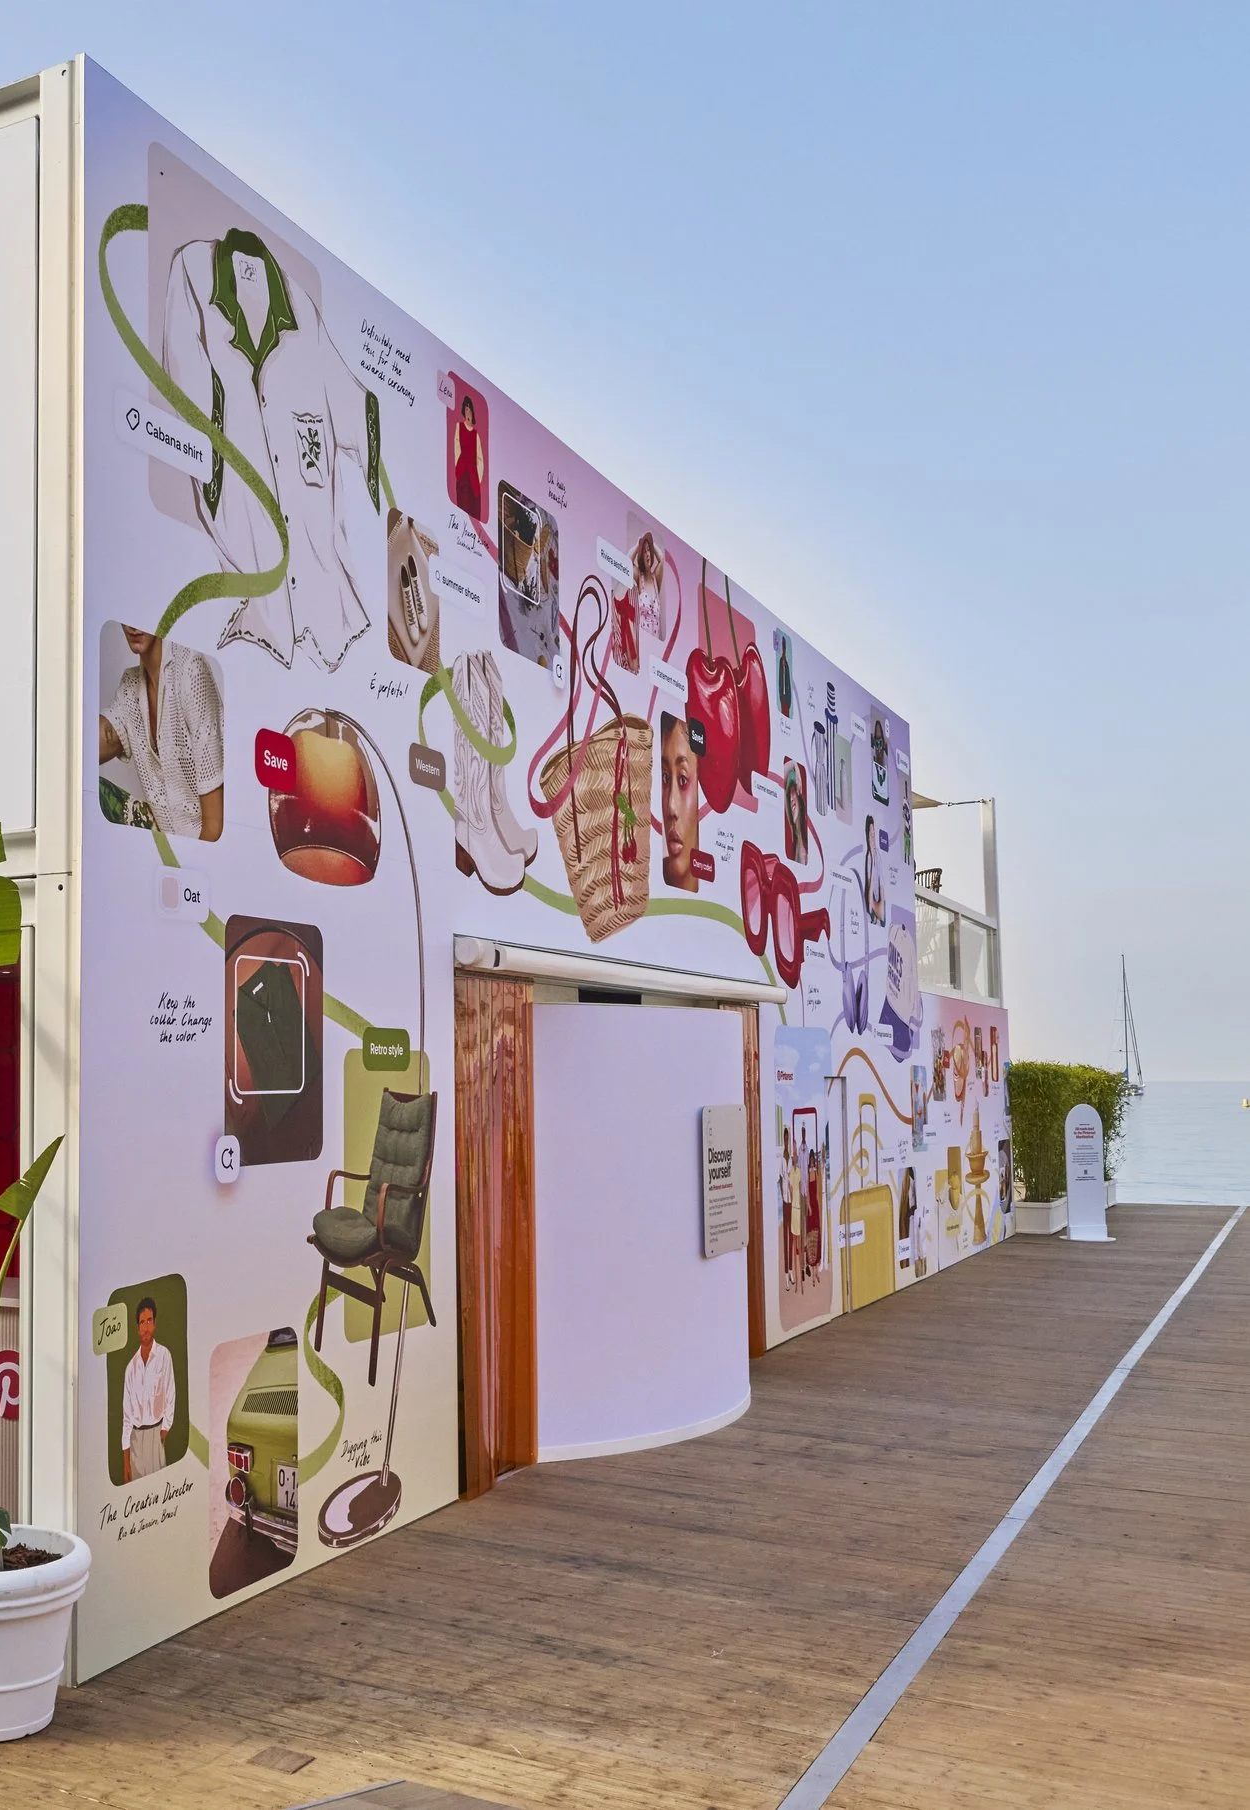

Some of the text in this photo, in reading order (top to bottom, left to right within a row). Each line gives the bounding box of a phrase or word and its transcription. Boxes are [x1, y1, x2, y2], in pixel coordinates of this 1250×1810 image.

[361, 318, 411, 364] Definitely need
[378, 350, 388, 365] for
[392, 360, 402, 376] the
[360, 360, 415, 407] awards ceremony
[146, 421, 203, 463] Cabana shirt
[448, 514, 458, 530] The
[442, 576, 480, 603] summer shoes
[370, 672, 409, 700] É perfeito!
[692, 730, 704, 744] Saved
[263, 749, 288, 772] Save
[415, 758, 440, 777] Western
[183, 888, 201, 903] Oat
[158, 992, 196, 1016] Keep the
[150, 1012, 212, 1033] collar. Change
[160, 1030, 197, 1043] the color.
[370, 1042, 404, 1058] Retro style
[708, 1148, 732, 1164] Discover
[708, 1162, 731, 1184] yourself
[98, 1316, 121, 1346] João
[340, 1429, 383, 1463] Digging this
[100, 1478, 194, 1531] The Creative Director
[118, 1526, 127, 1541] Rio
[130, 1522, 136, 1534] de
[161, 1505, 179, 1523] Brazil
